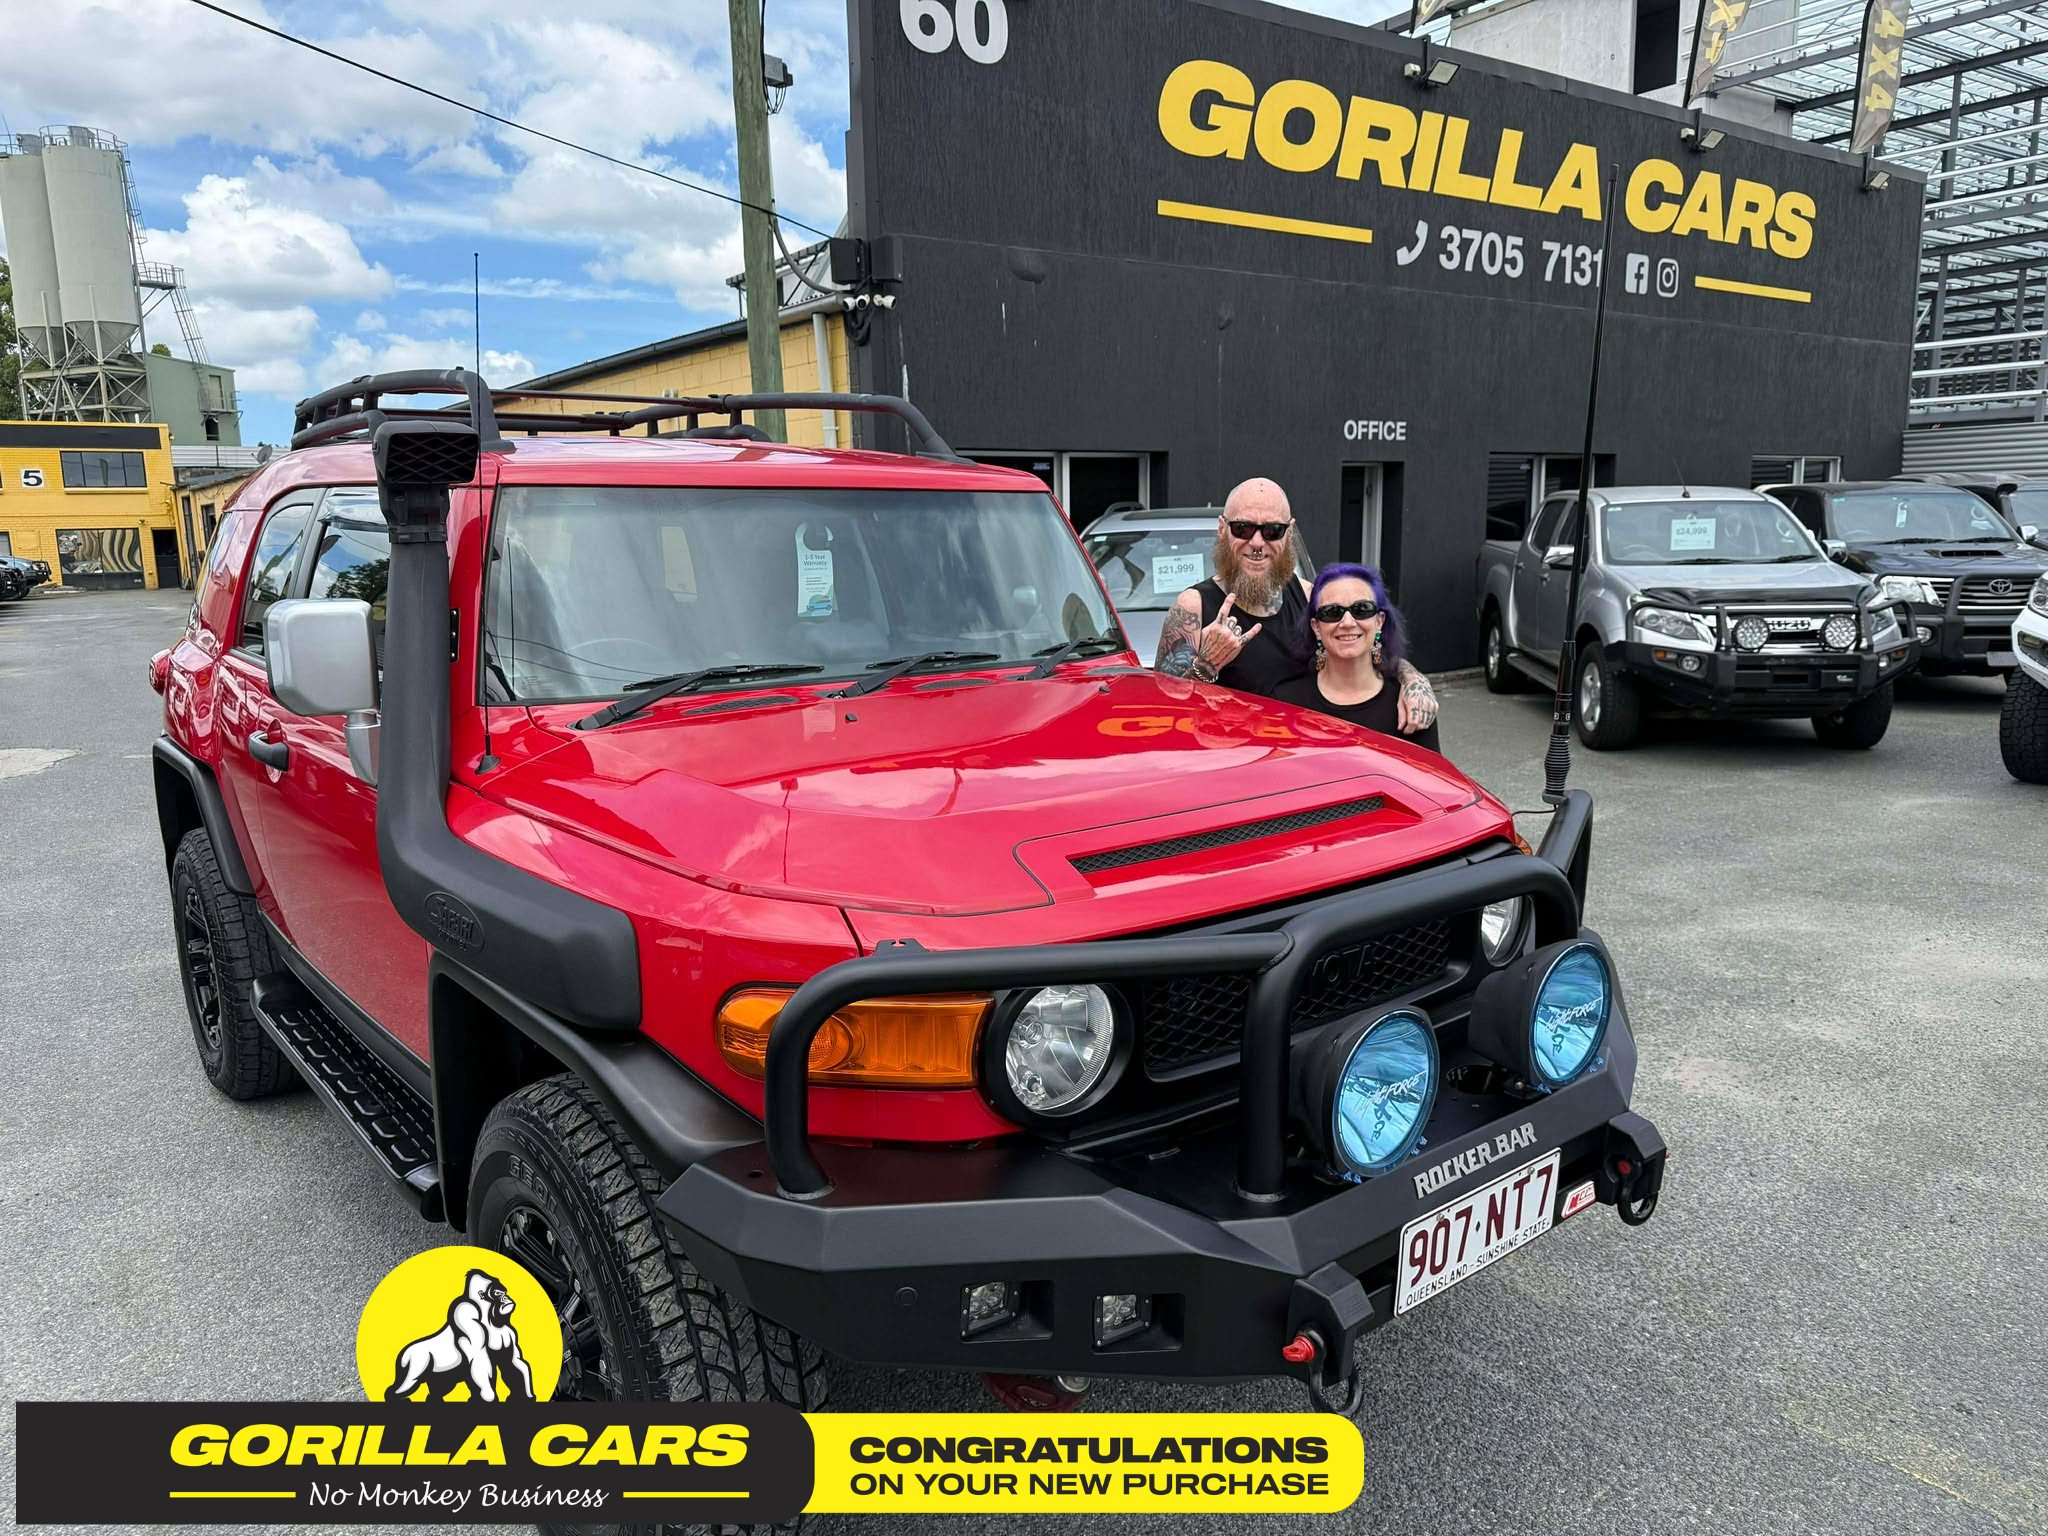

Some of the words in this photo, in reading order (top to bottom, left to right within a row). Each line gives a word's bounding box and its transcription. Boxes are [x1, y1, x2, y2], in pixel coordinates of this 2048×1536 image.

[900, 0, 1008, 65] 60
[1865, 10, 1905, 112] 4X4
[1159, 60, 1602, 220] GORILLA
[1627, 159, 1817, 259] CARS
[1438, 225, 1524, 279] 3705
[1542, 240, 1604, 288] 7131
[1343, 420, 1407, 441] OFFICE
[23, 470, 43, 487] 5
[1158, 563, 1195, 574] $21,999
[1768, 619, 1811, 631] UZU
[1413, 1142, 1494, 1200] ROCKER
[1494, 1121, 1538, 1159] BAR
[1406, 1264, 1468, 1306] QUEENSLAND
[1476, 1235, 1519, 1267] SUNSHINE
[1522, 1220, 1548, 1241] STATE
